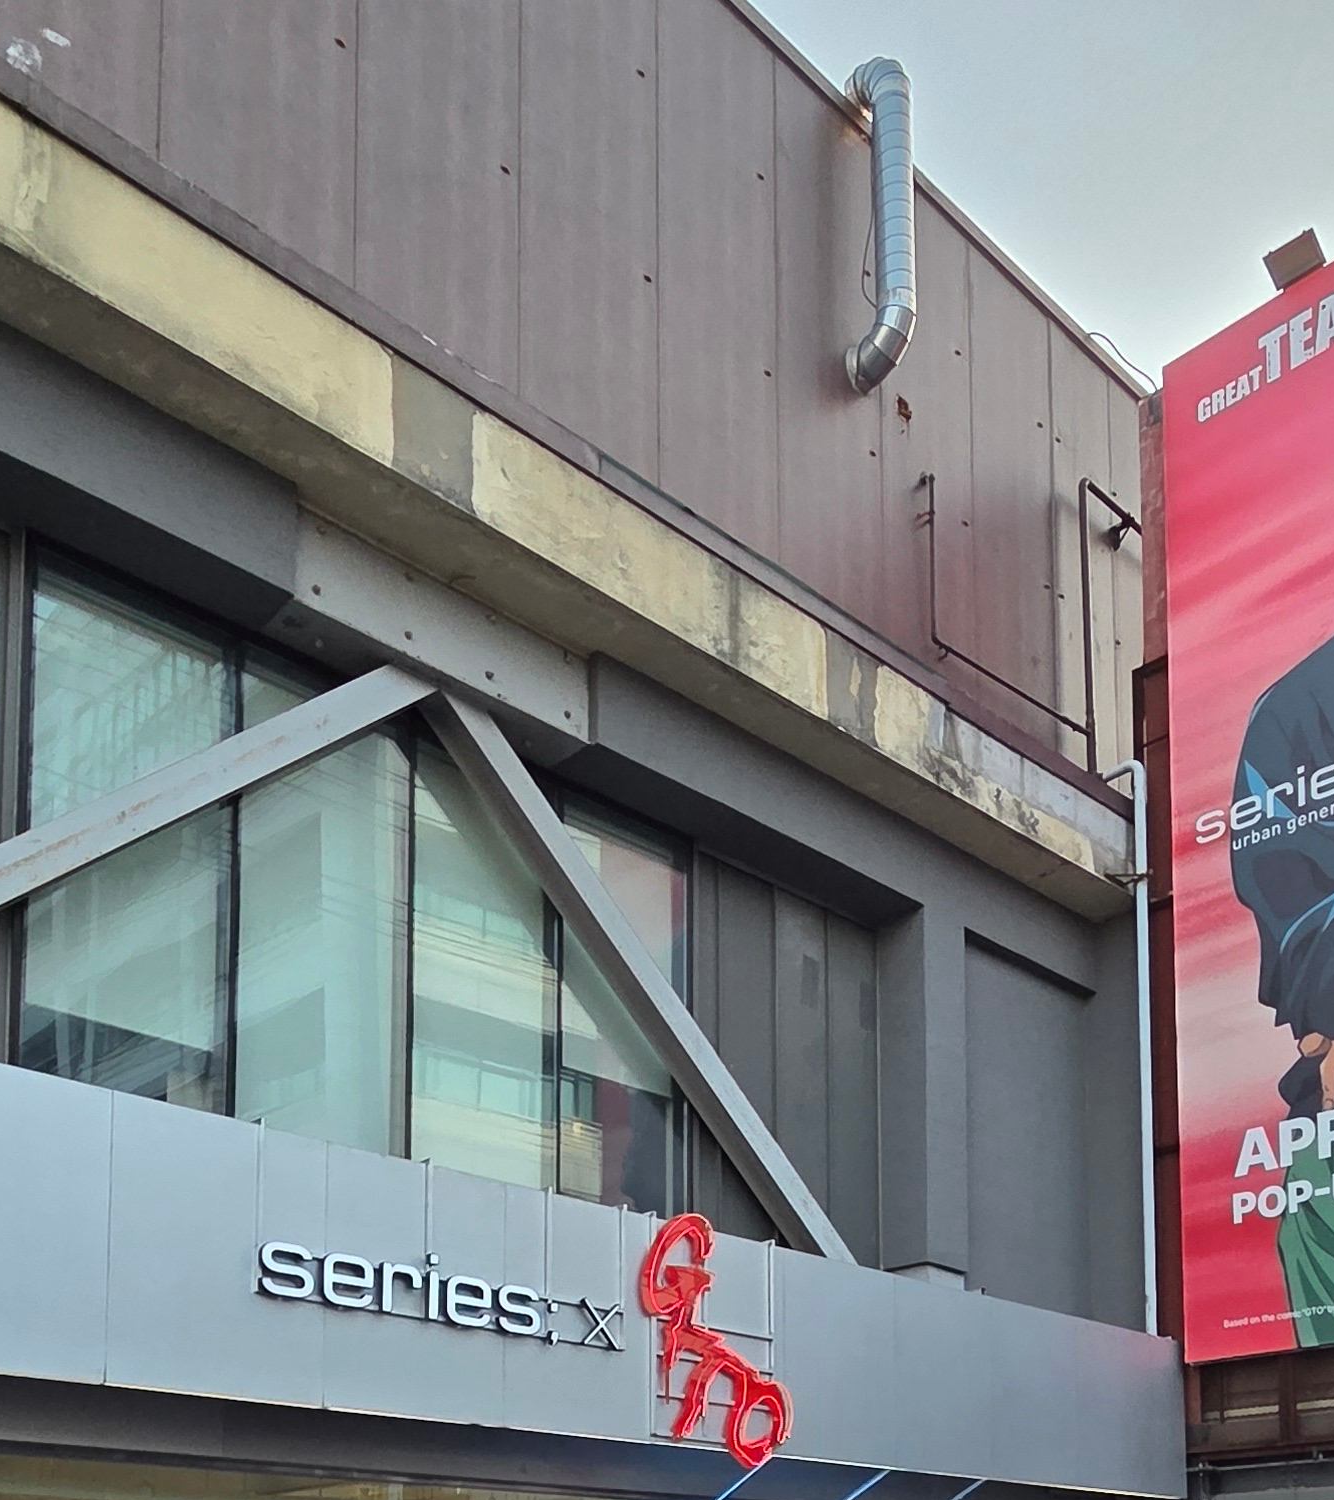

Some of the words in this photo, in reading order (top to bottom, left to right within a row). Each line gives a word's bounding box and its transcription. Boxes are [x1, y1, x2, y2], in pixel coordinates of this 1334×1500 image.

[1197, 364, 1263, 423] GREAT
[1232, 824, 1281, 851] urban
[1223, 1316, 1249, 1328] Based
[1250, 1315, 1261, 1325] on
[1261, 1313, 1276, 1323] the
